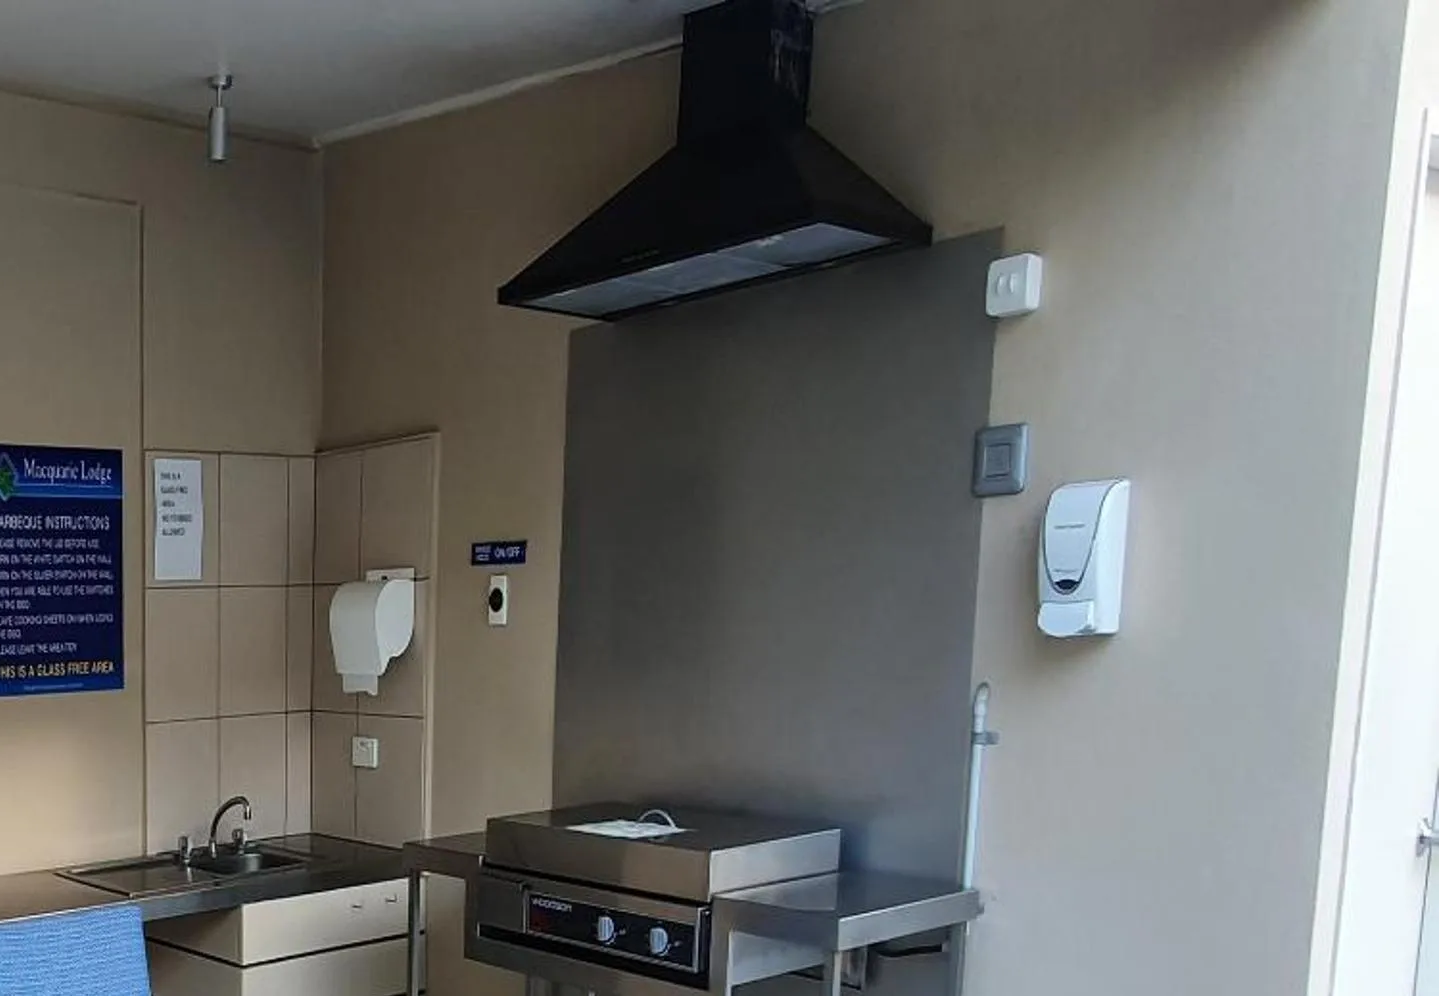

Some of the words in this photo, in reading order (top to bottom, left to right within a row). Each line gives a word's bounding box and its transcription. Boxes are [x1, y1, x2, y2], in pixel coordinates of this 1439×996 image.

[23, 457, 79, 485] Macquarie
[80, 460, 112, 484] Lodge
[45, 514, 110, 531] INSTRUCTIONS
[17, 665, 27, 678] IS
[28, 664, 35, 677] A
[37, 663, 65, 677] GLASS
[67, 661, 90, 675] FREE
[91, 660, 115, 673] AREA
